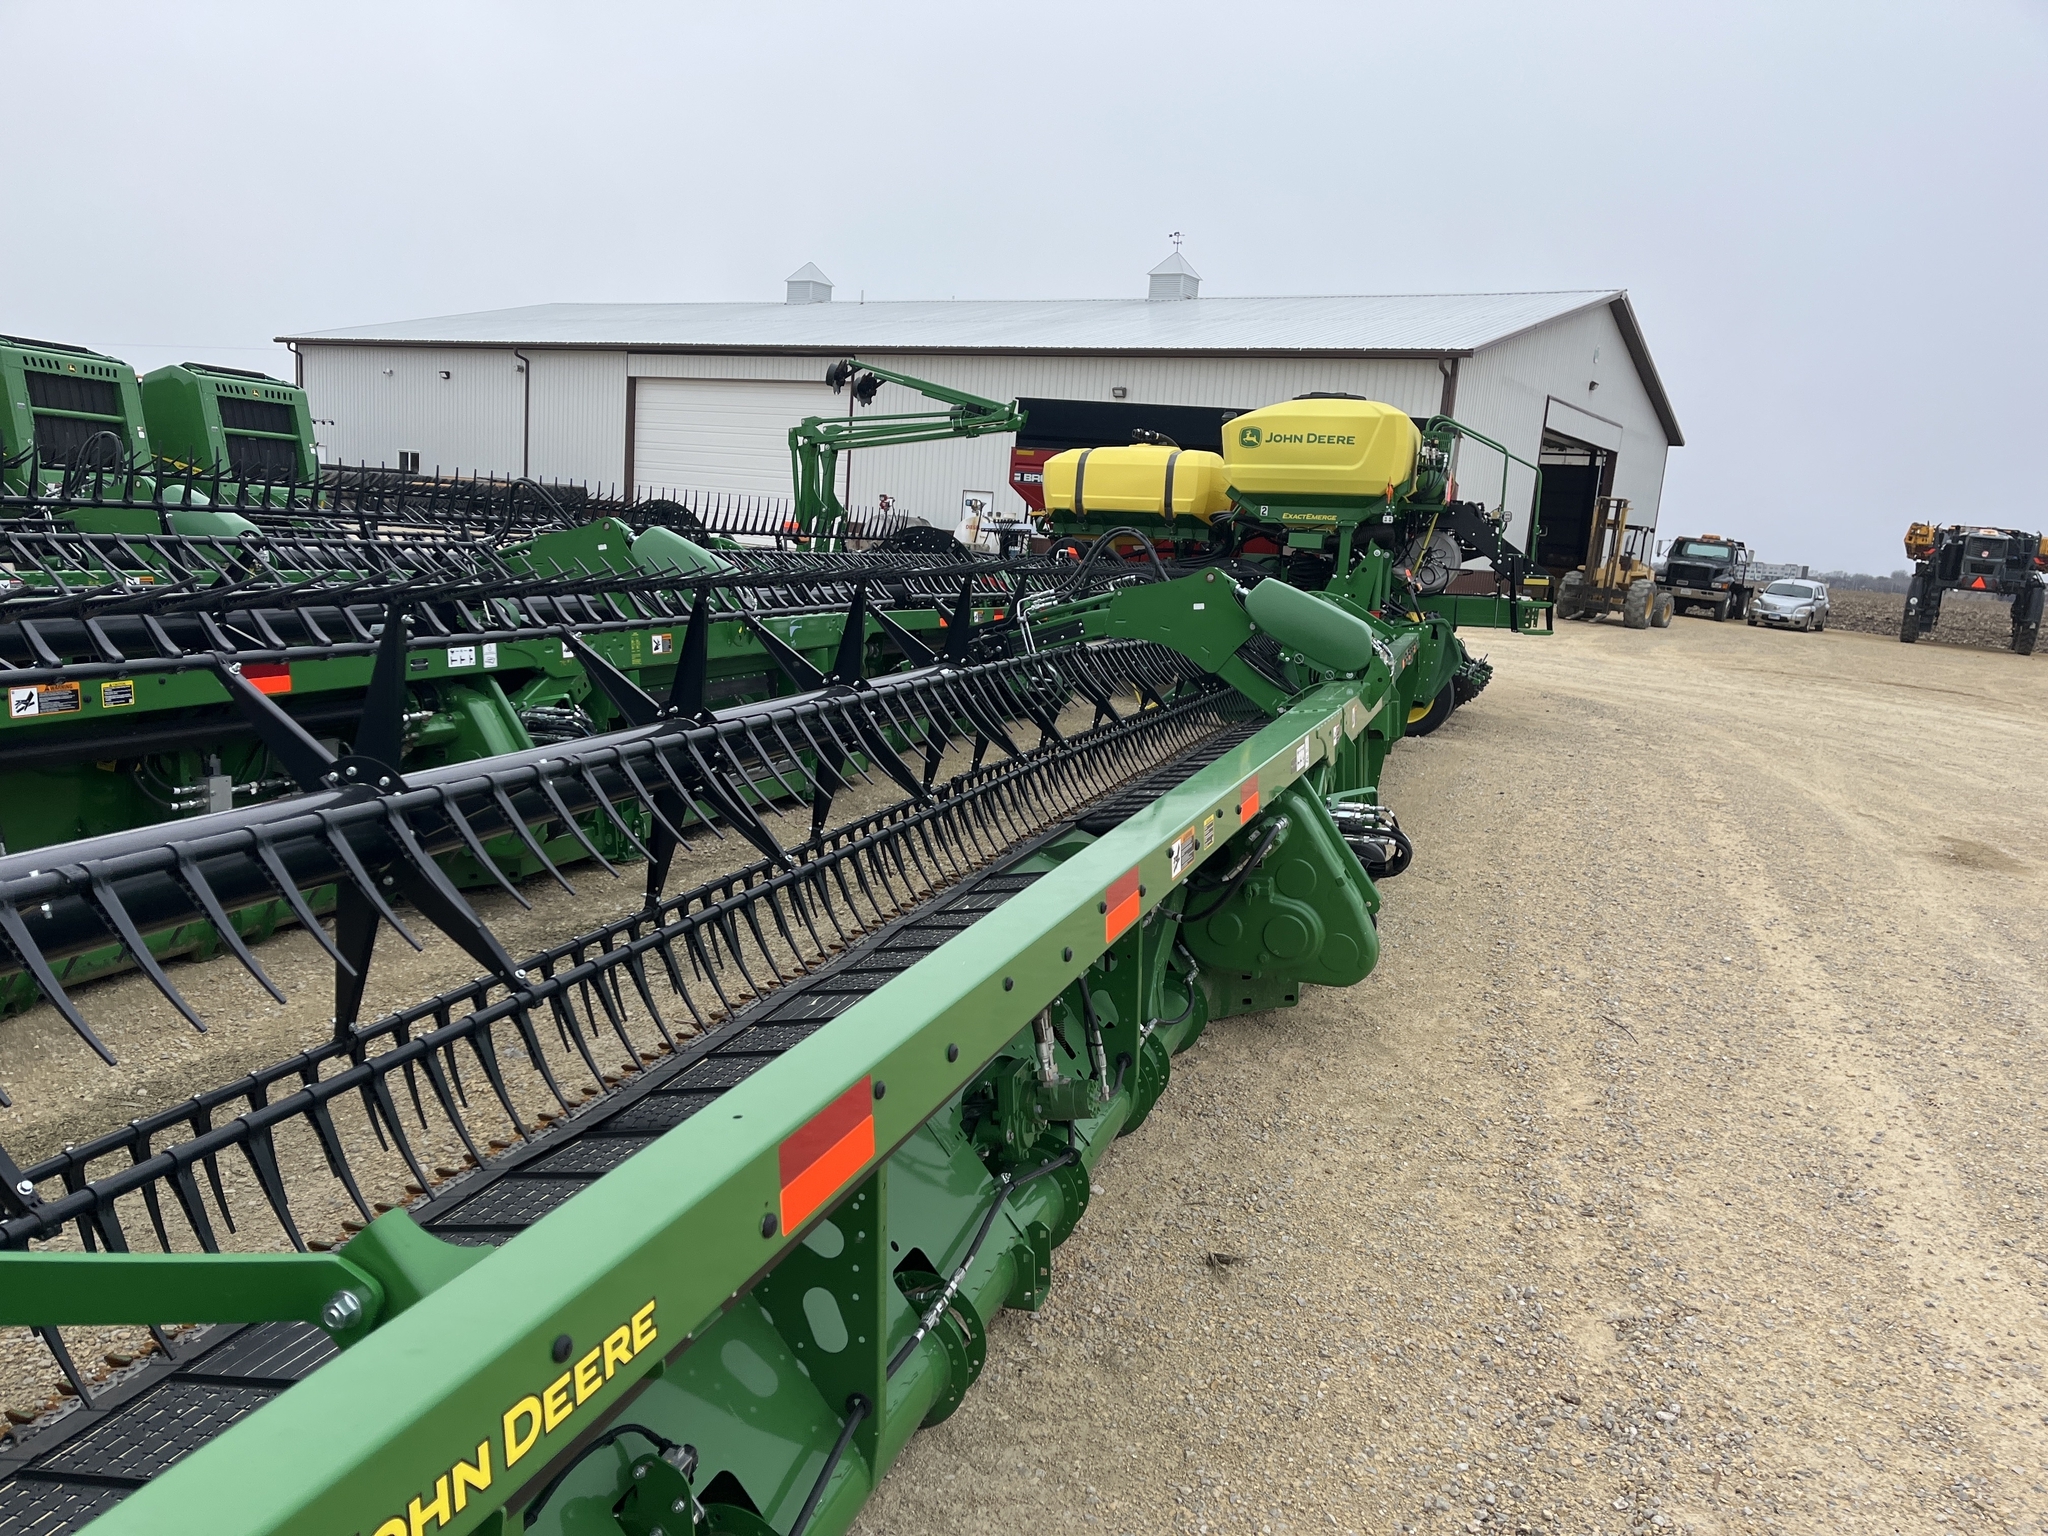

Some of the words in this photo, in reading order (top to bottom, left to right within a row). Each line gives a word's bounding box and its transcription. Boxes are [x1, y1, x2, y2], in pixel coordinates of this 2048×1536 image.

[1265, 432, 1303, 443] JOHN
[1306, 433, 1355, 445] DEERE
[1261, 507, 1267, 516] 2
[502, 1298, 658, 1469] DEERE
